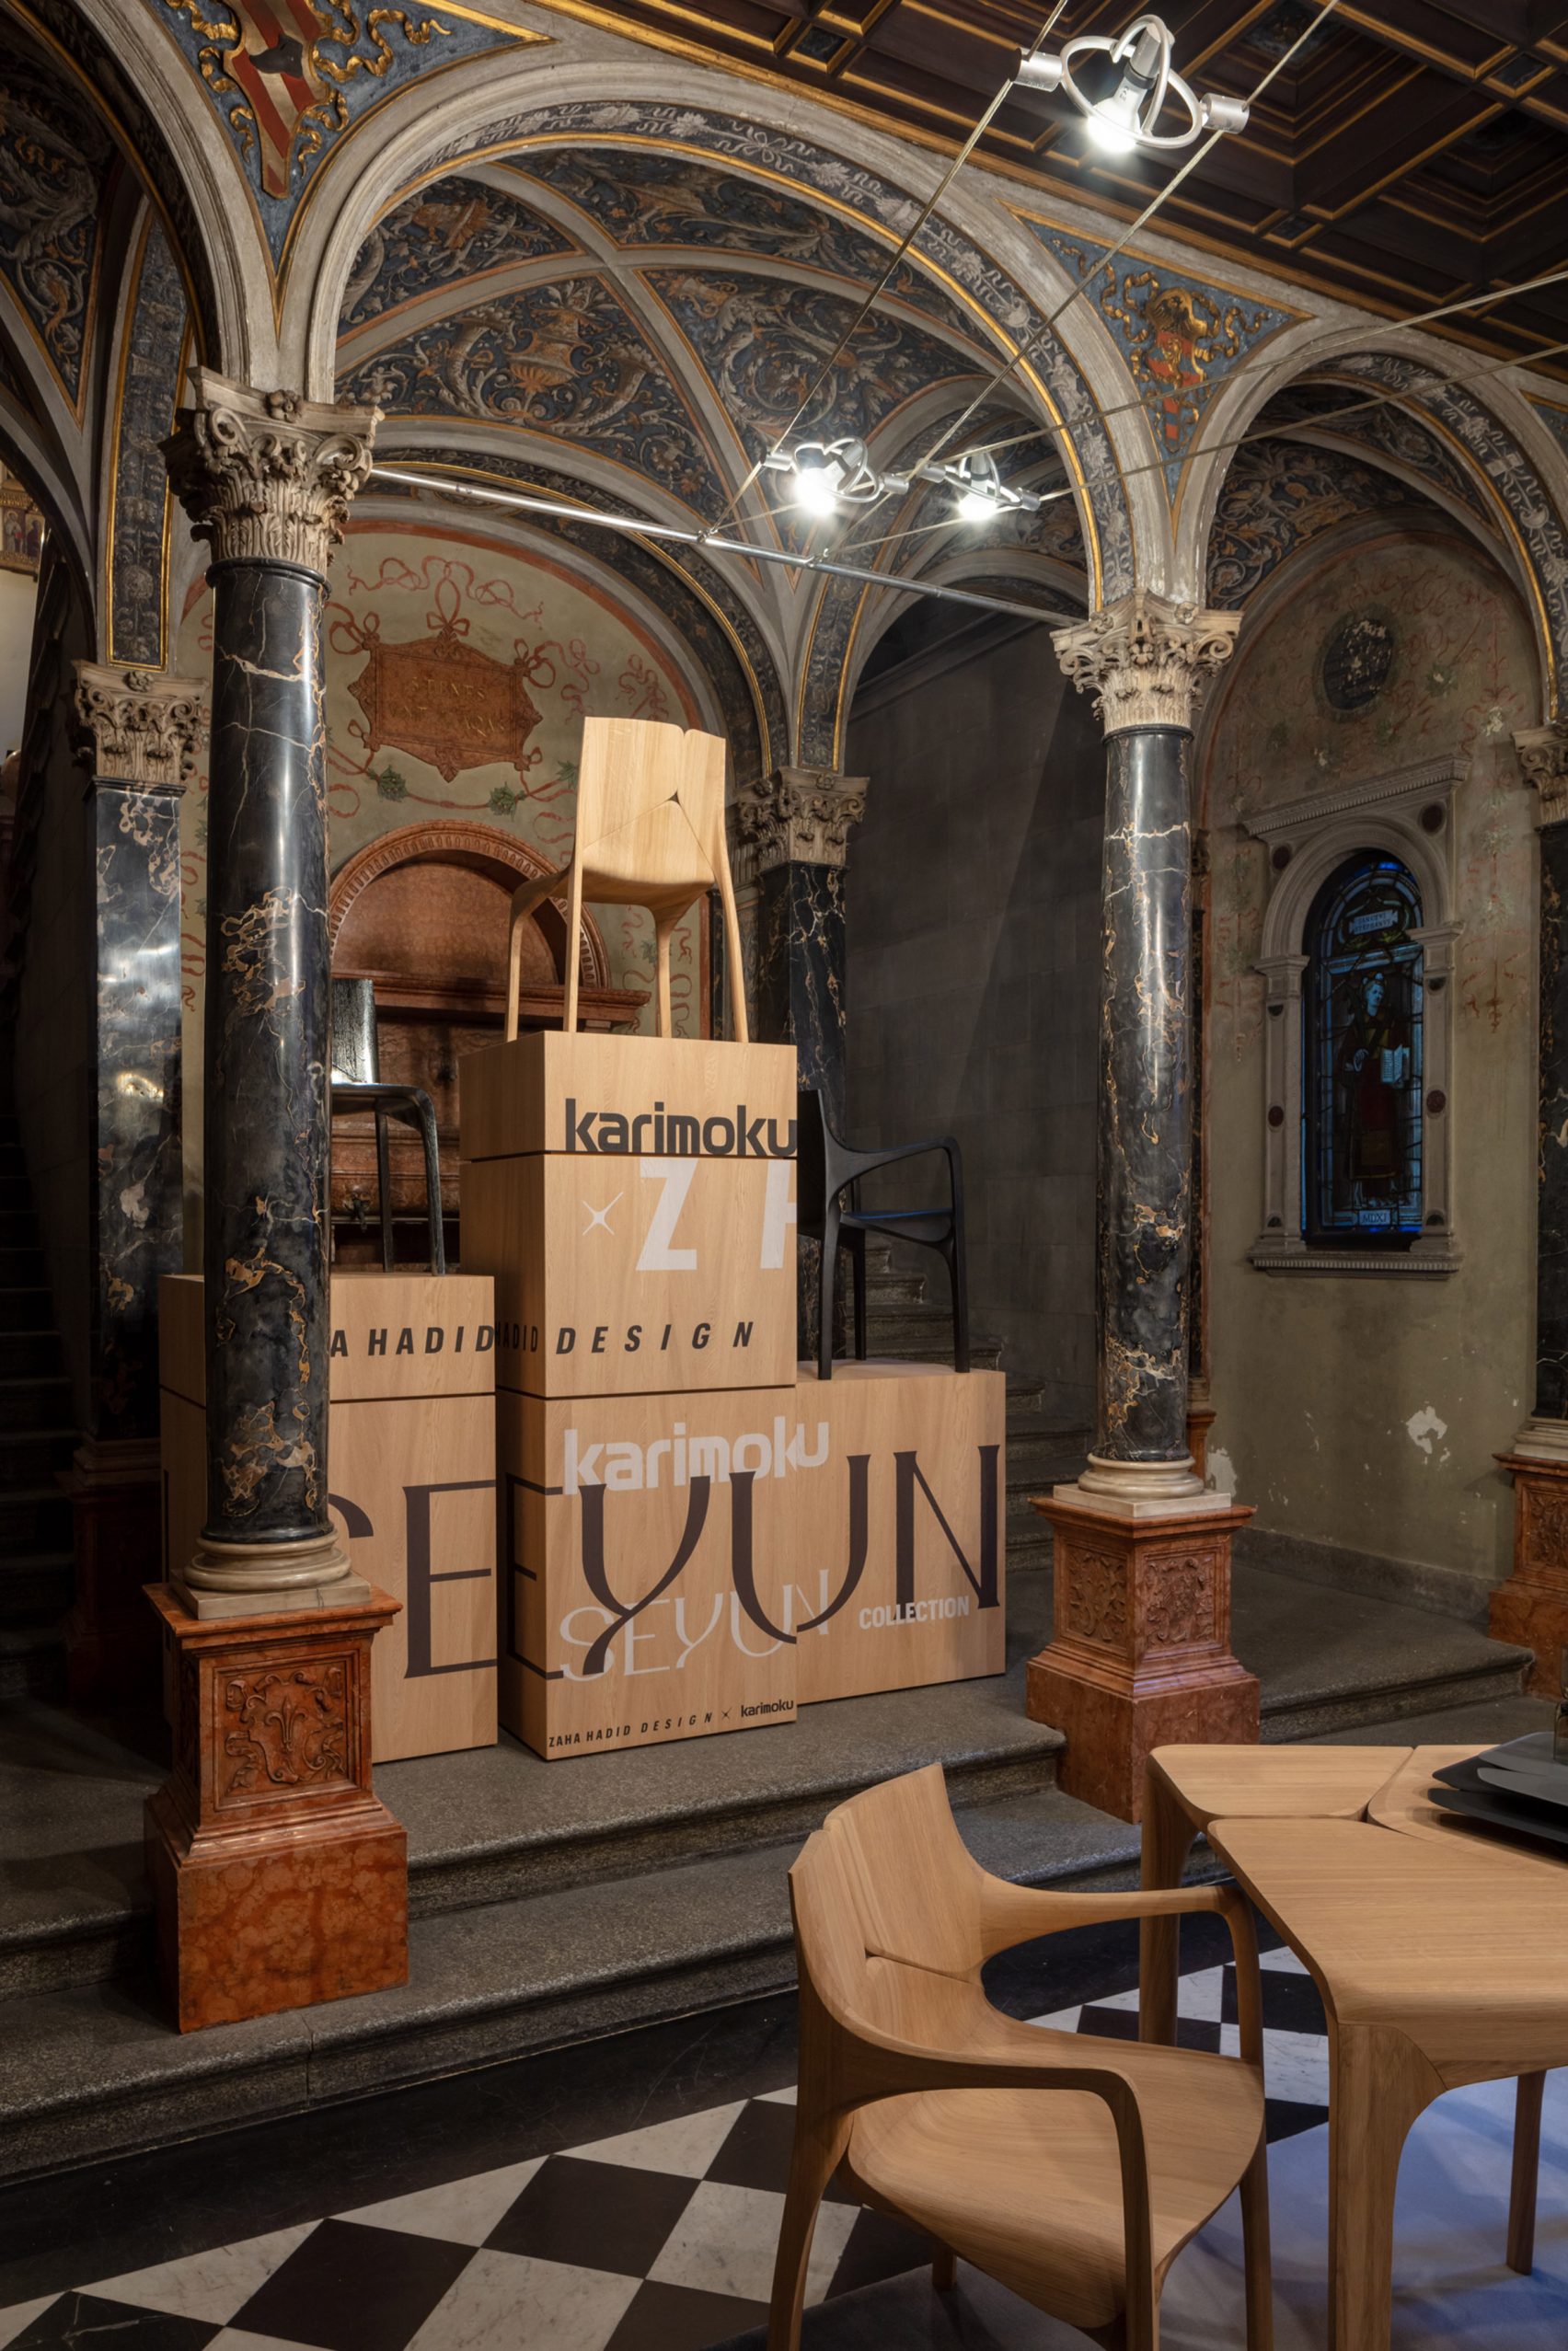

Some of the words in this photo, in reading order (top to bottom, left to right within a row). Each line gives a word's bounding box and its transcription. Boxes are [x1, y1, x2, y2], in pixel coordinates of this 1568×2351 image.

[565, 1098, 798, 1157] karimoku
[368, 1325, 495, 1357] HADID
[555, 1321, 754, 1354] DESIGN
[564, 1415, 829, 1495] karimoku
[859, 1595, 971, 1631] COLLECTION
[548, 1732, 582, 1748] ZAHA
[586, 1724, 631, 1742] HADID
[640, 1711, 713, 1734] DESIGN
[740, 1700, 794, 1718] karimoku
